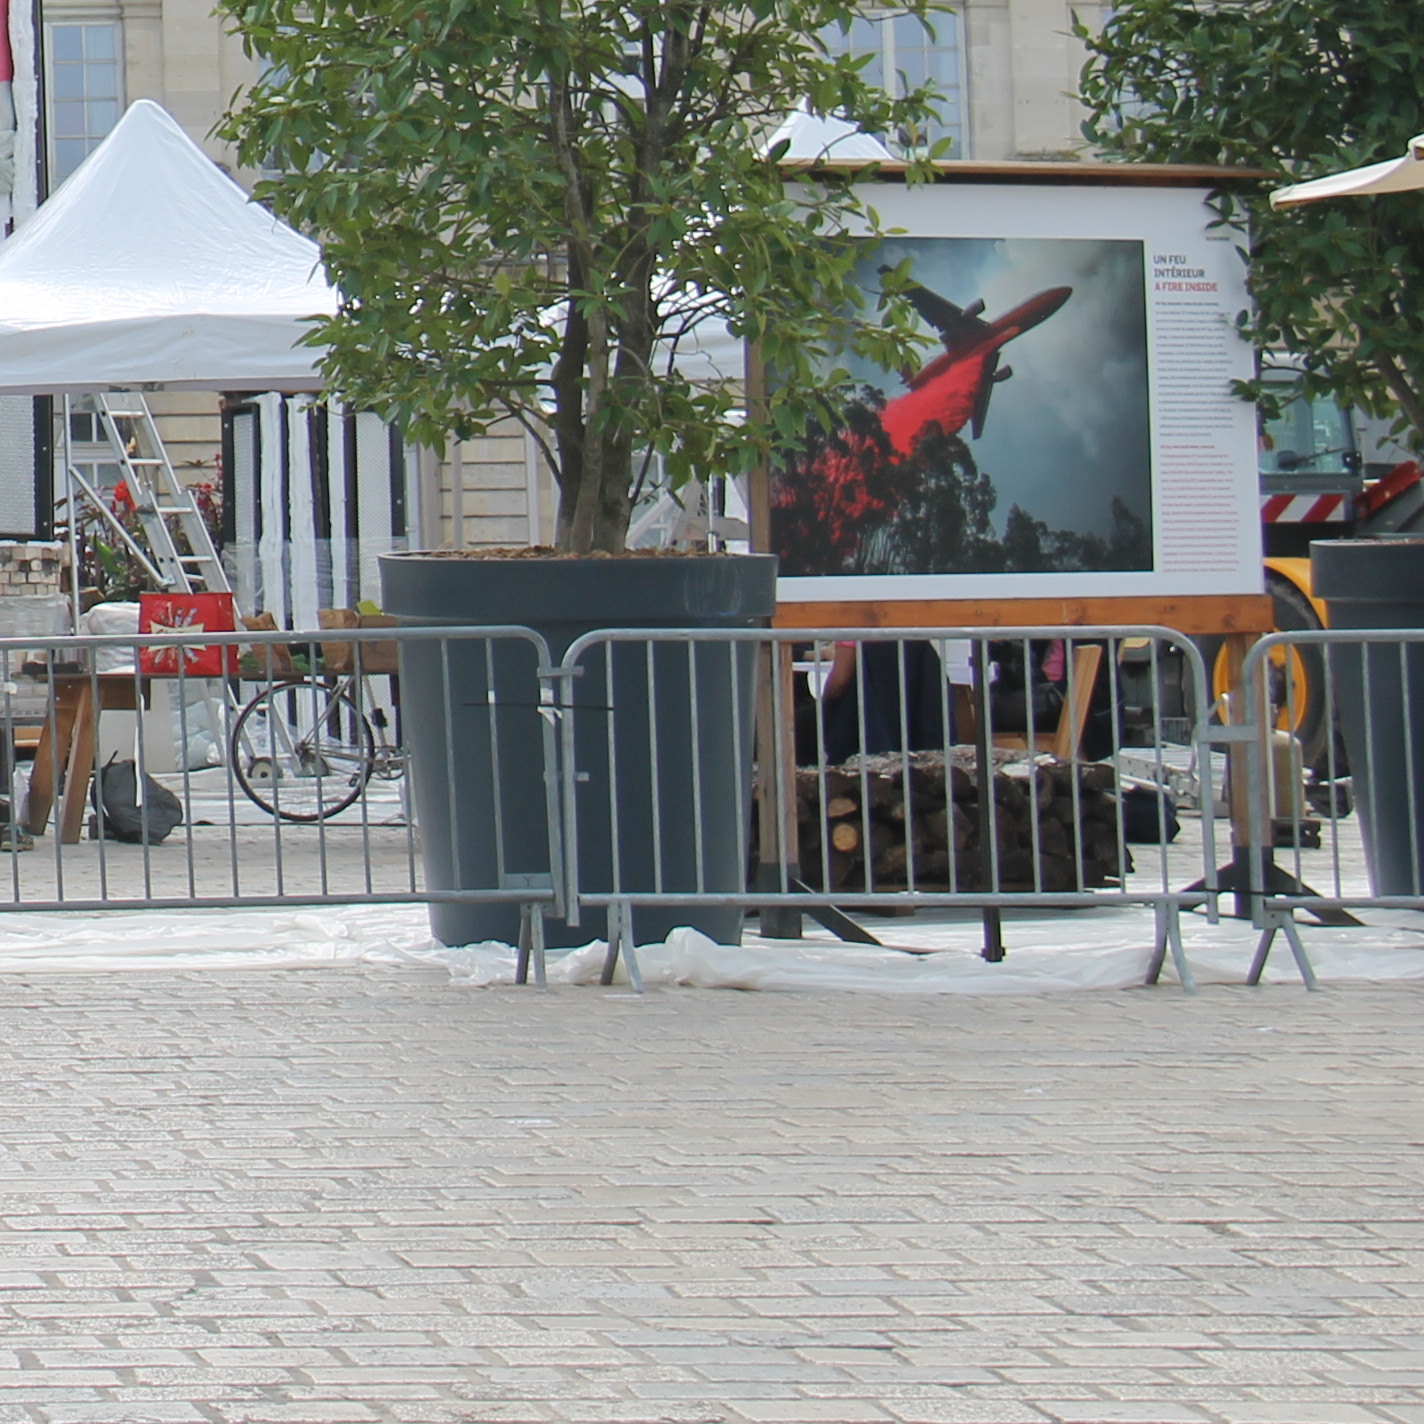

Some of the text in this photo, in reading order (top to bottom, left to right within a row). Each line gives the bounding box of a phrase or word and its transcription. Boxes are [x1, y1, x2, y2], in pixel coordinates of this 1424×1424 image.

[1153, 255, 1186, 265] UN FEU
[1154, 266, 1205, 279] INTÉRIEUR
[1154, 281, 1218, 292] A FIRE INSIDE
